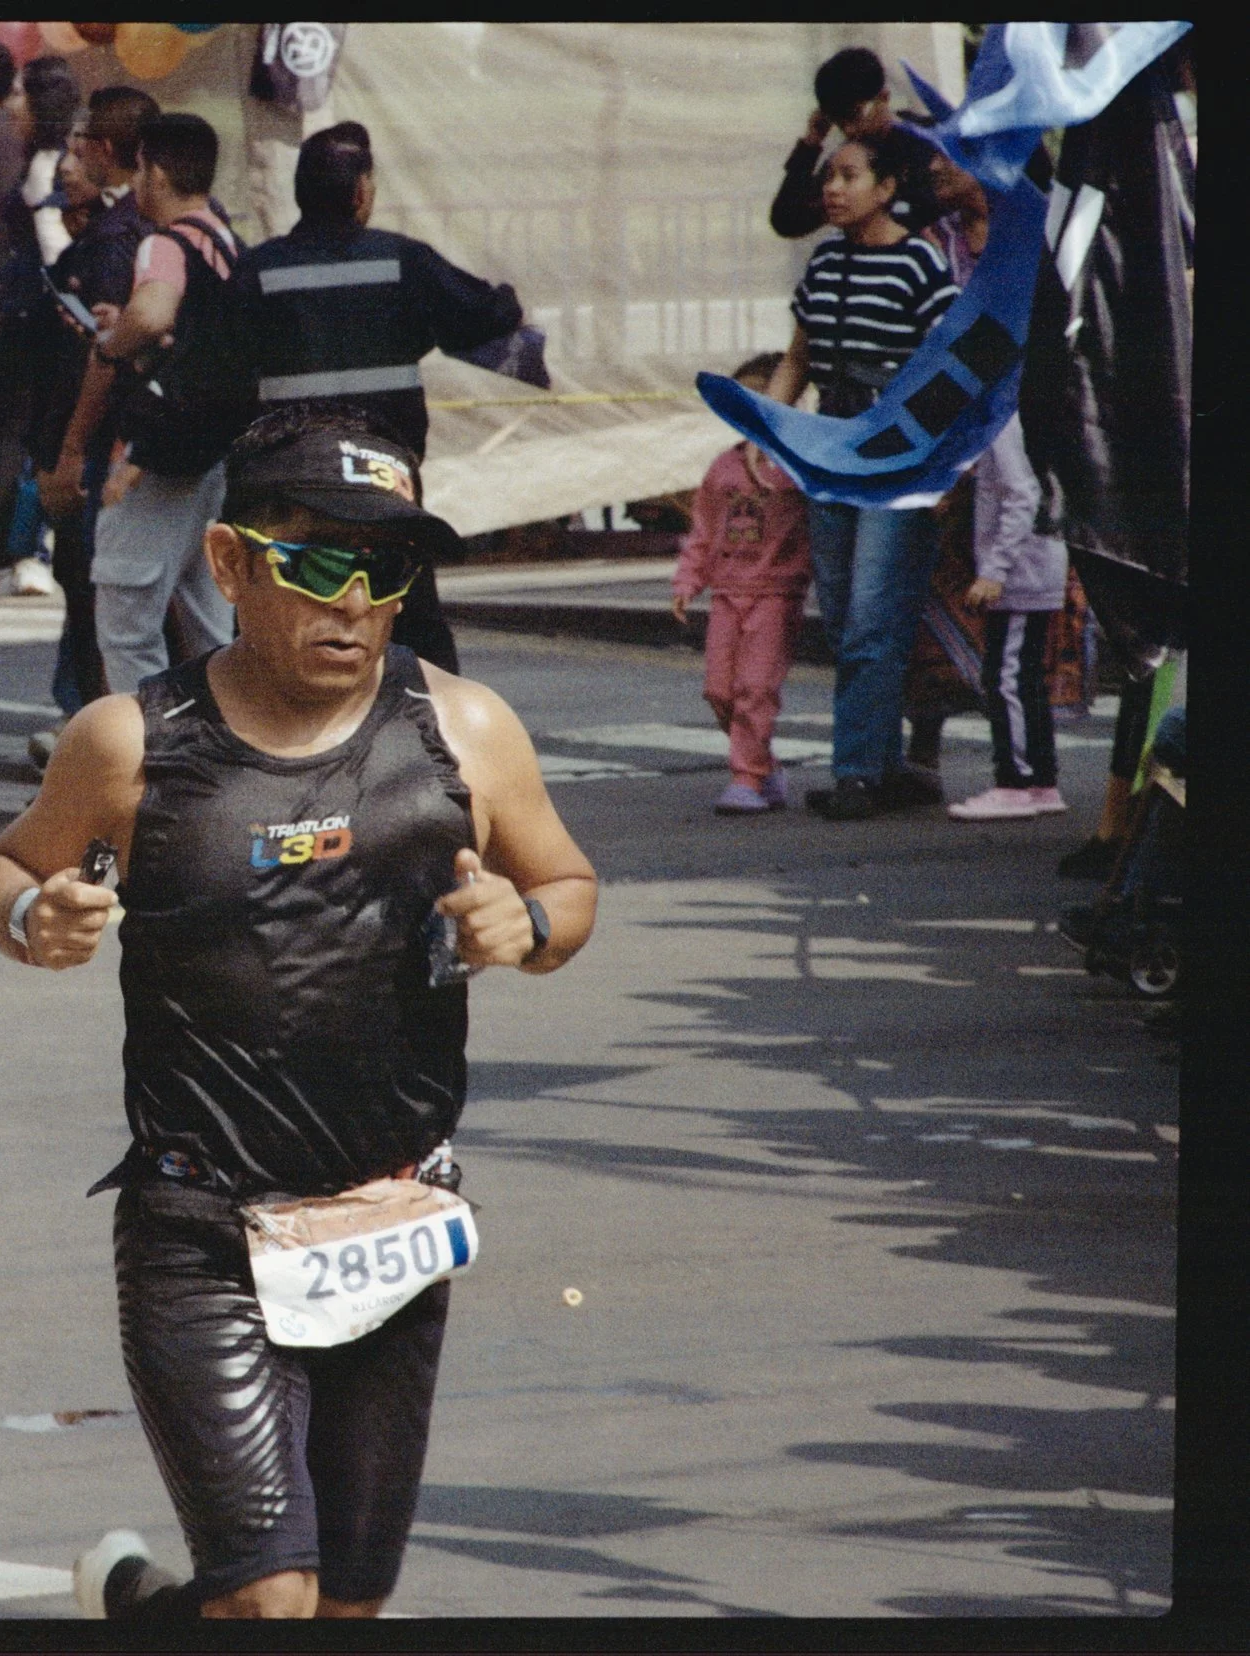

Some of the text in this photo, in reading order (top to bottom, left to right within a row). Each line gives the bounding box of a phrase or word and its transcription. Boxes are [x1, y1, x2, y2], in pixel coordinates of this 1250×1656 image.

[342, 456, 414, 502] L3D
[249, 827, 354, 870] L3D
[268, 814, 352, 839] TRIATLON
[302, 1224, 438, 1300] 2850
